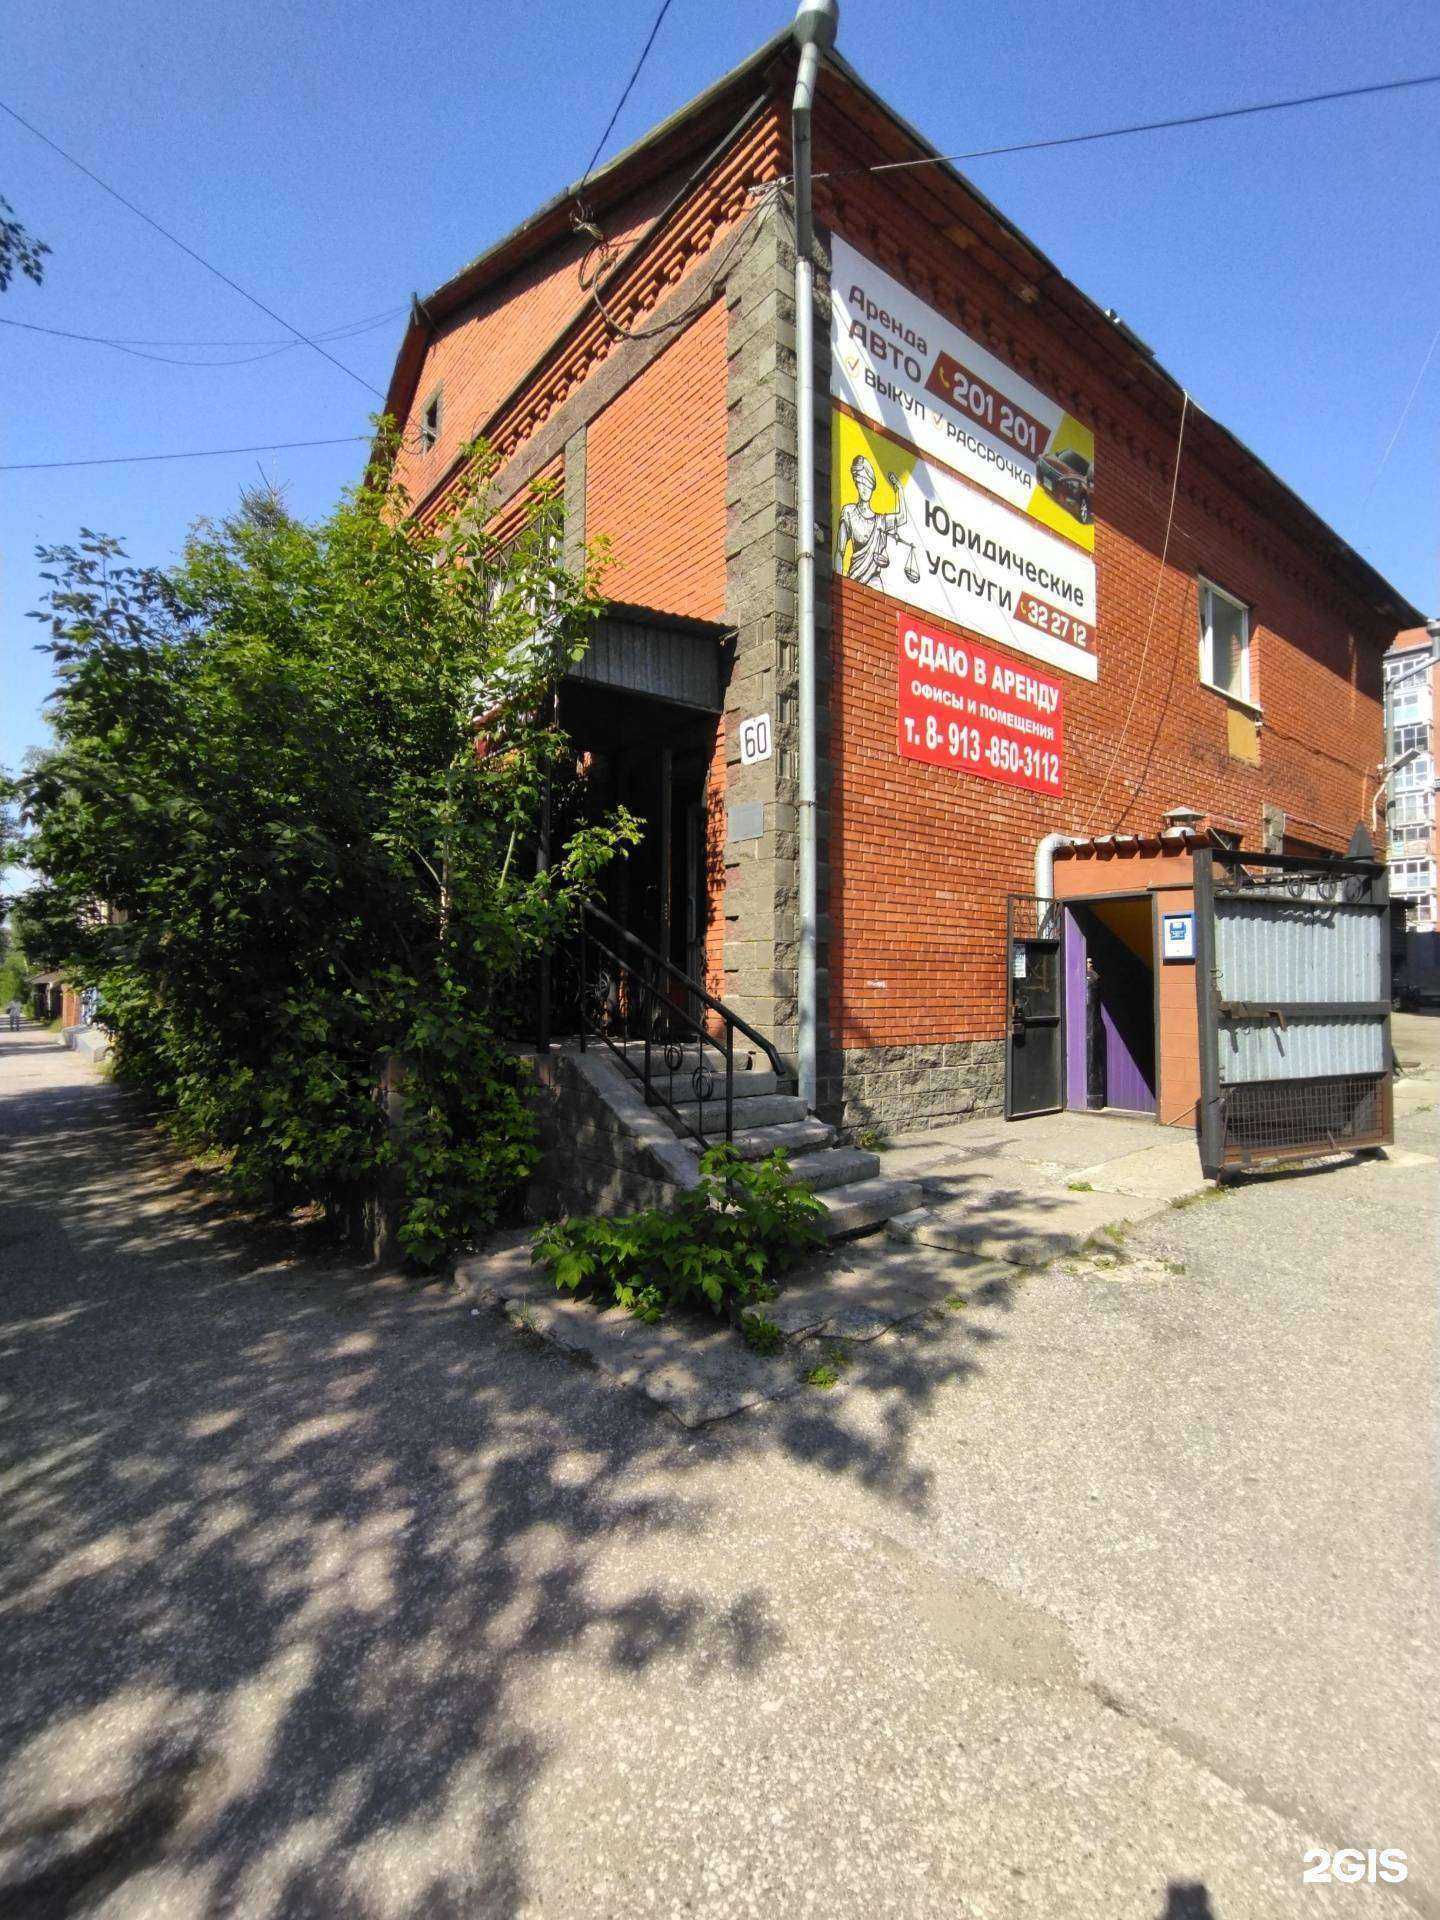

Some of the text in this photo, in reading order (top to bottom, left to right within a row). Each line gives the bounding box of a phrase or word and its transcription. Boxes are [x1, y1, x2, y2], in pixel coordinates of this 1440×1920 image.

[849, 284, 928, 357] Аренда
[849, 319, 922, 383] АВТО
[952, 371, 1037, 454] 201 201
[946, 421, 1033, 490] РАССРОЧКА
[924, 499, 1085, 607] Юридические
[1027, 600, 1087, 647] 32 27 12
[904, 629, 1059, 715] СДАЮ В АРЕНДУ
[744, 721, 767, 758] 60
[911, 679, 1054, 742] ОФИСЫ И ПОМЕЩЕНИЯ
